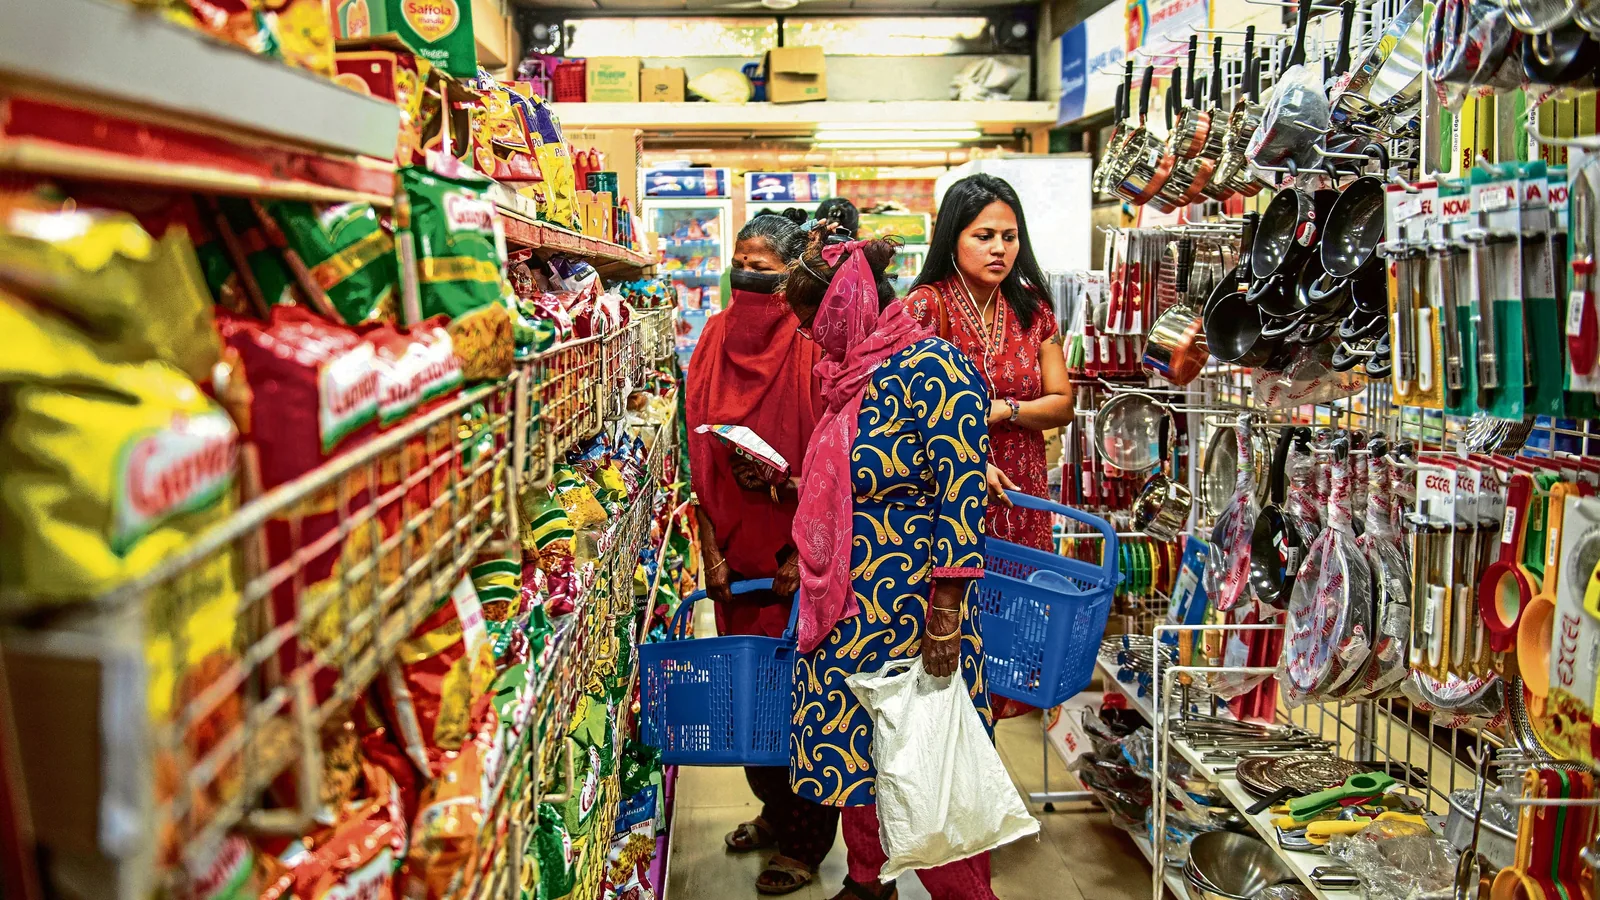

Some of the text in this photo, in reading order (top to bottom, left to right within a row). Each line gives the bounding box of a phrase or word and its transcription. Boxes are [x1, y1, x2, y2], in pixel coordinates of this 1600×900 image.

[408, 2, 452, 16] Saffola
[420, 48, 449, 60] Veggie
[1425, 475, 1451, 494] EXCEL
[1456, 475, 1475, 494] XCEL
[1557, 611, 1581, 687] EXCEL
